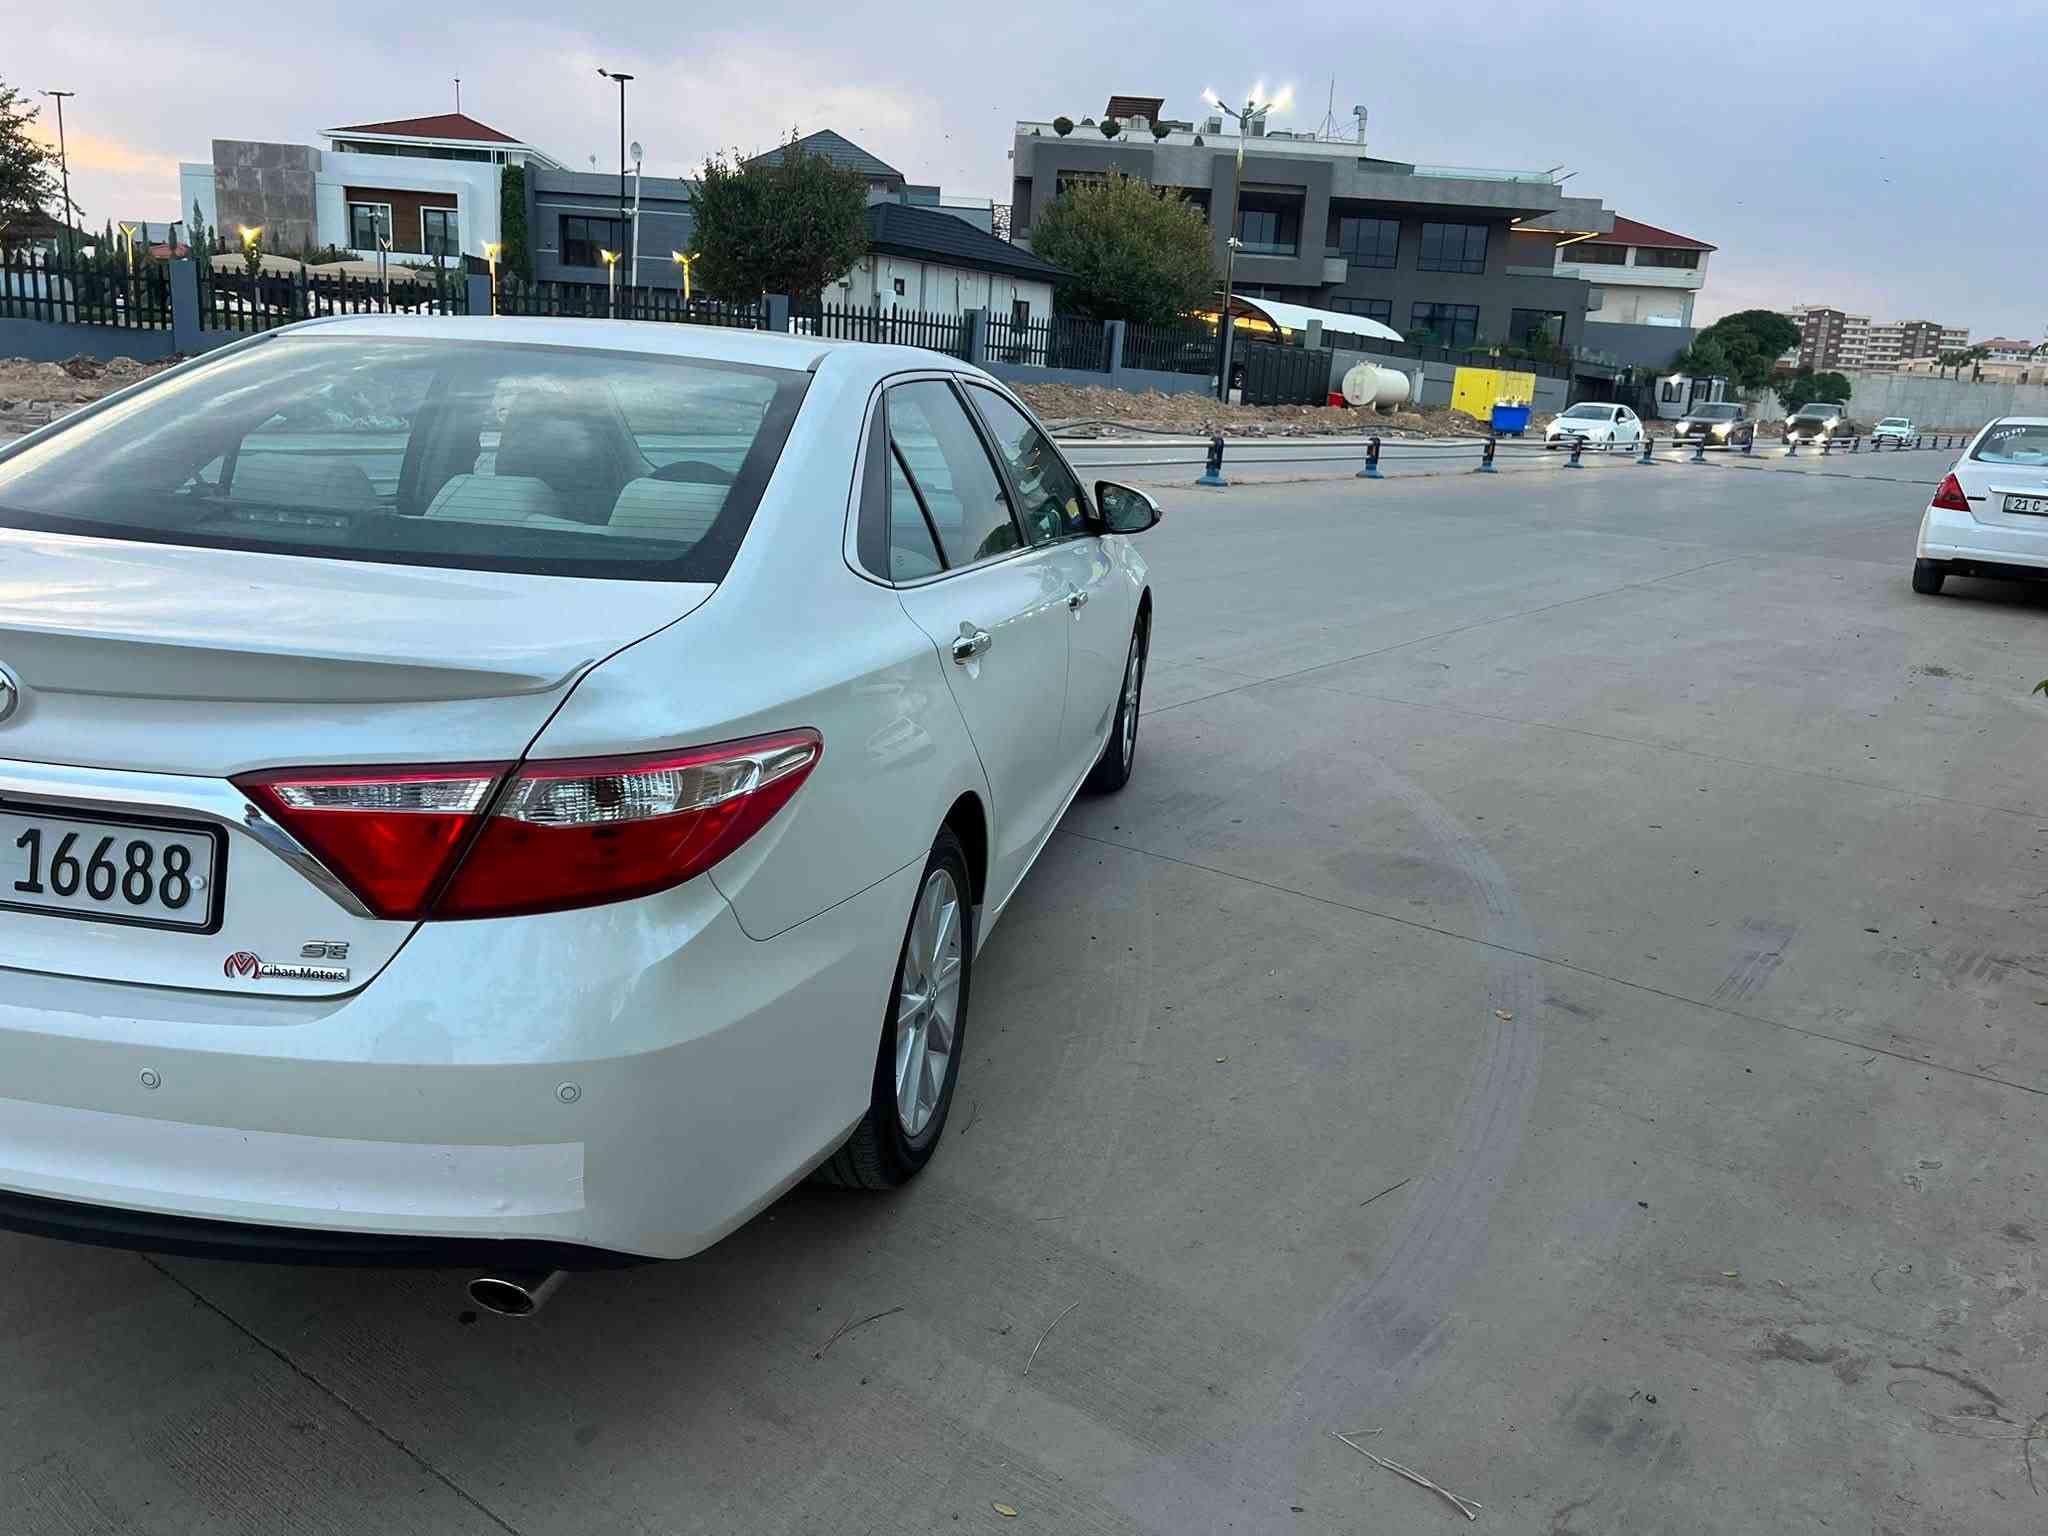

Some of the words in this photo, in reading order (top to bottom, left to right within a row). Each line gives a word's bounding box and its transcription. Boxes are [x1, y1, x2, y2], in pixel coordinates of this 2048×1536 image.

[2014, 499, 2028, 510] 21
[2033, 500, 2041, 511] C
[14, 828, 191, 909] 16688
[300, 940, 350, 960] SE
[261, 965, 297, 978] Cihan
[300, 967, 345, 981] Motors
